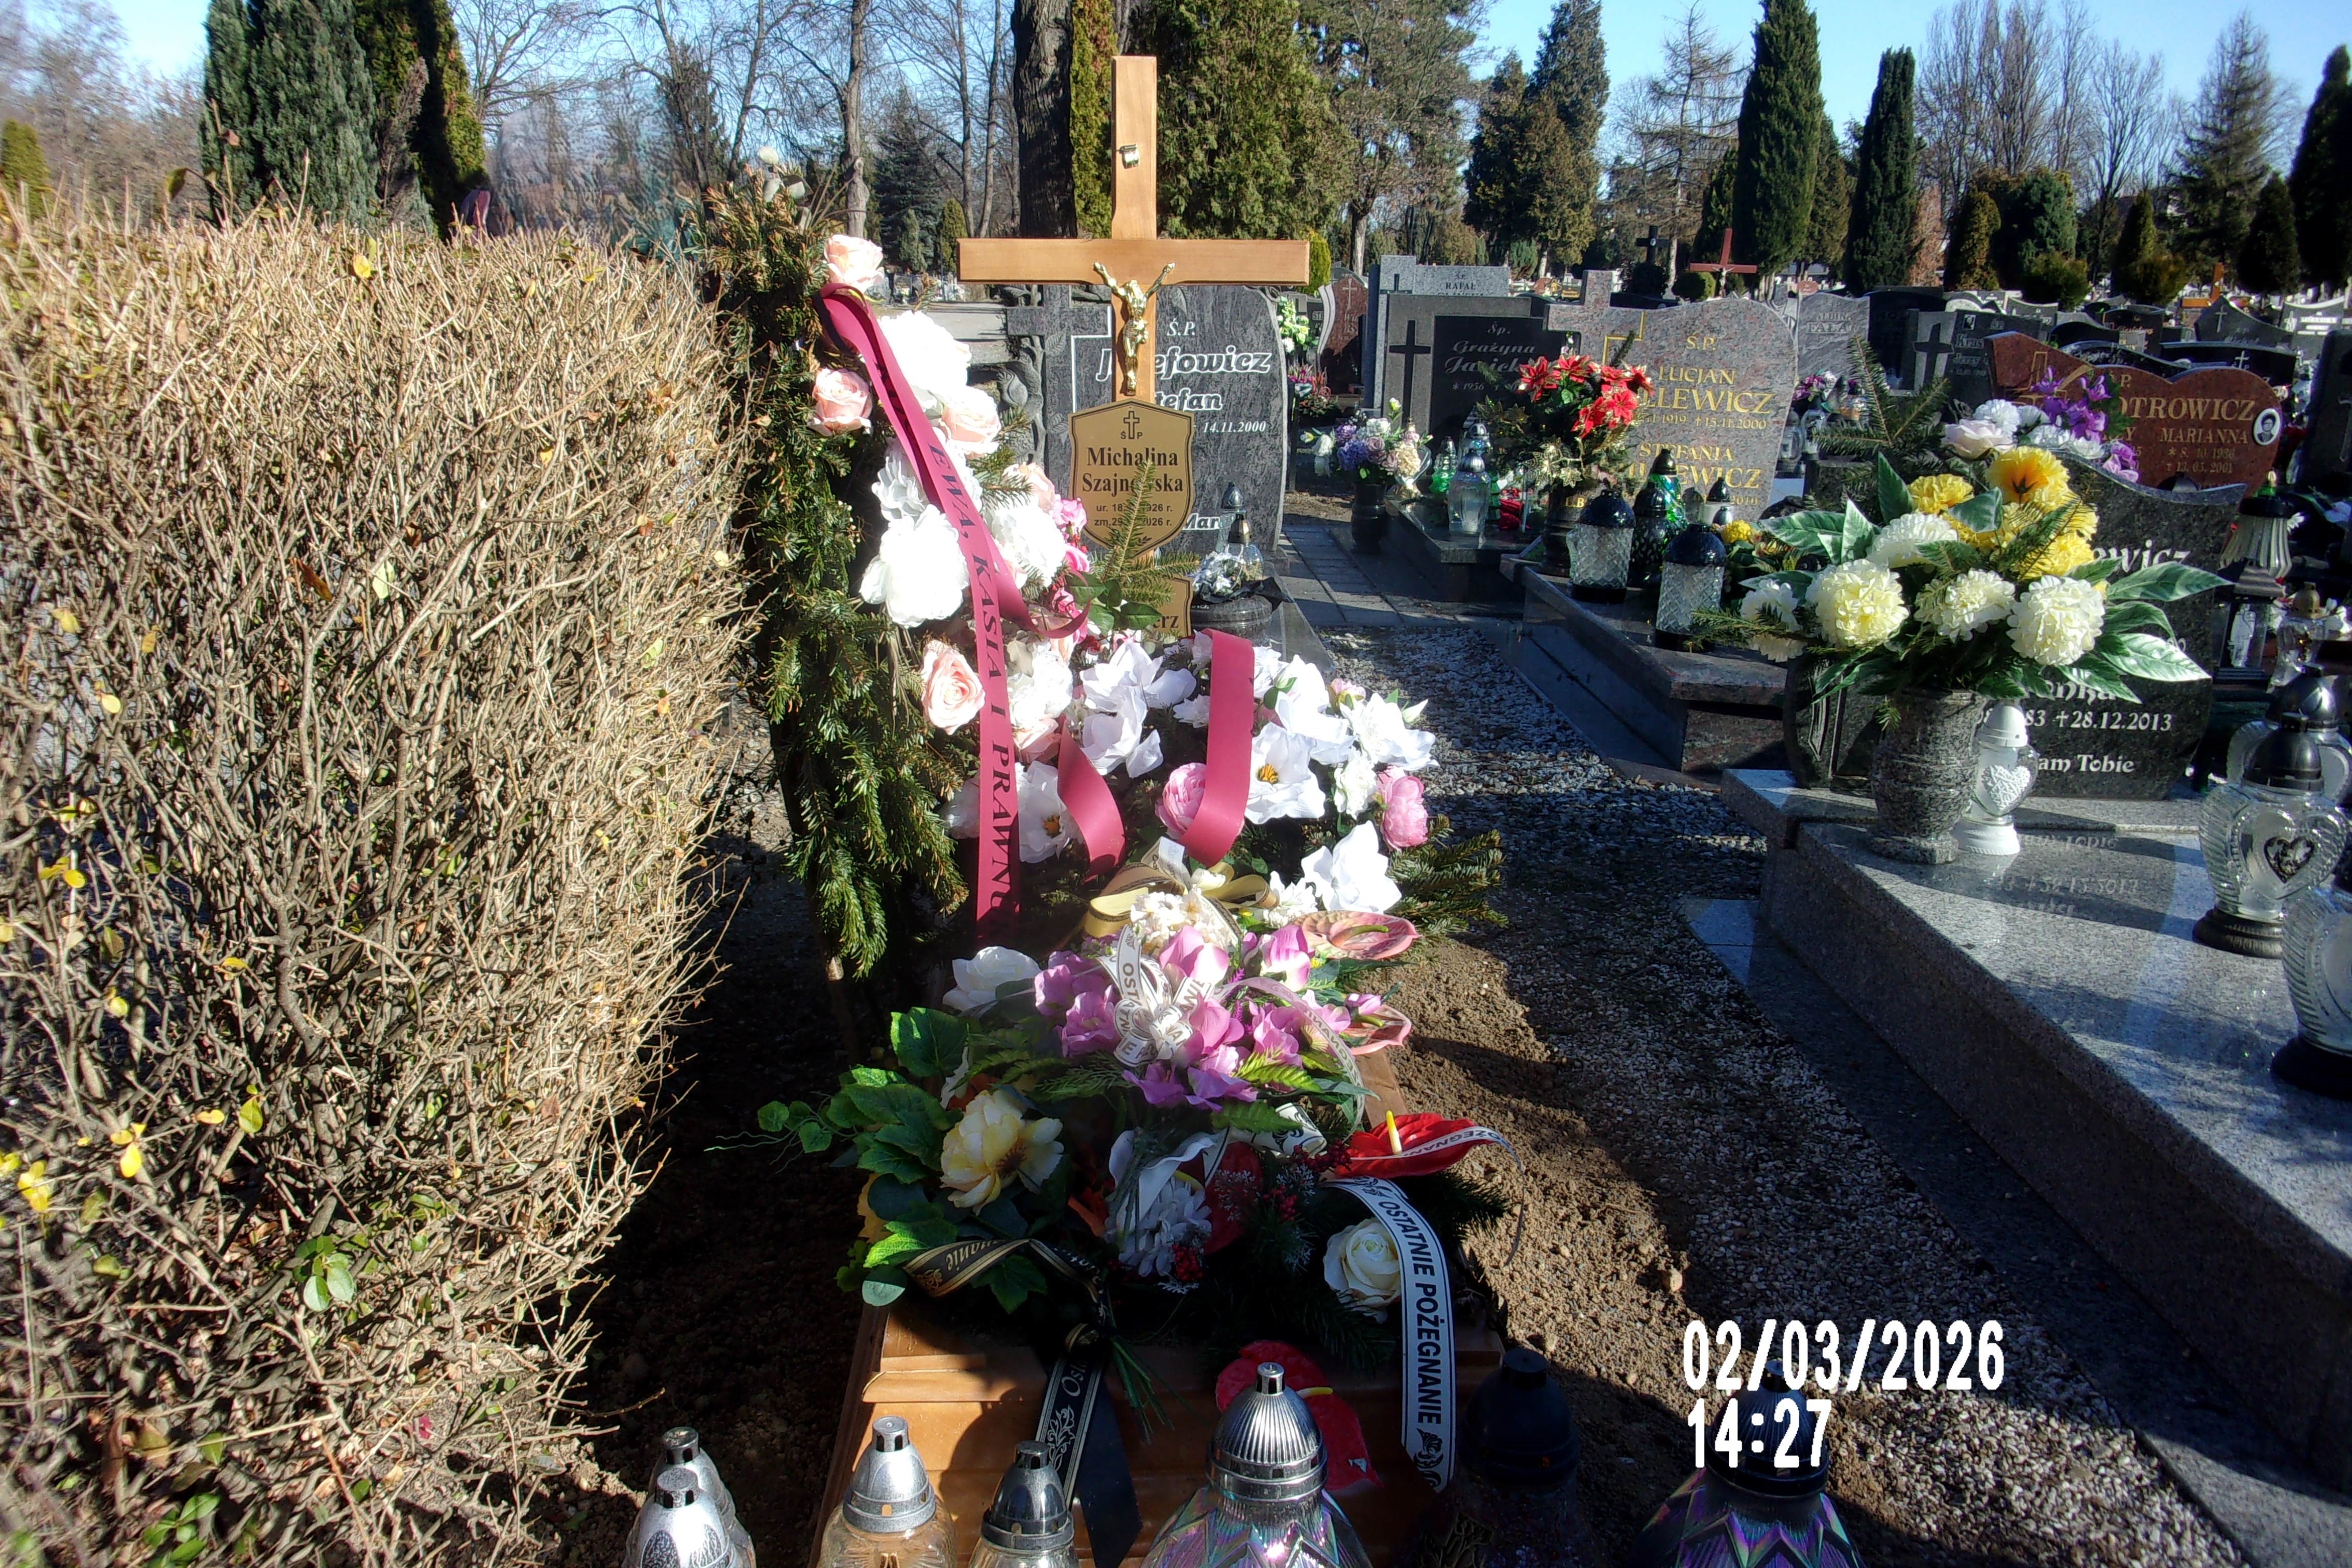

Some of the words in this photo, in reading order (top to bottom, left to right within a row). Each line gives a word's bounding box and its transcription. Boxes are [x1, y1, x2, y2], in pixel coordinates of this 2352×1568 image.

[1446, 282, 1476, 290] RAFAŁ
[1167, 318, 1196, 337] Ś.P.
[1453, 340, 1536, 355] Grażyna
[1686, 332, 1717, 351] Ś.P.
[1095, 345, 1272, 382] Jefowicz
[1444, 356, 1520, 374] Jaick
[1658, 366, 1736, 385] LUCJAN
[1202, 421, 1266, 433] 14.11.2000
[2159, 428, 2249, 445] MARIANNA
[1087, 447, 1179, 467] Michalina
[1082, 473, 1184, 498] Szajnska
[972, 551, 1002, 680] KASIA
[2076, 754, 2136, 774] Tobie
[1378, 1200, 1435, 1277] OSTATNIE
[1414, 1282, 1445, 1426] POŻEGNANIE
